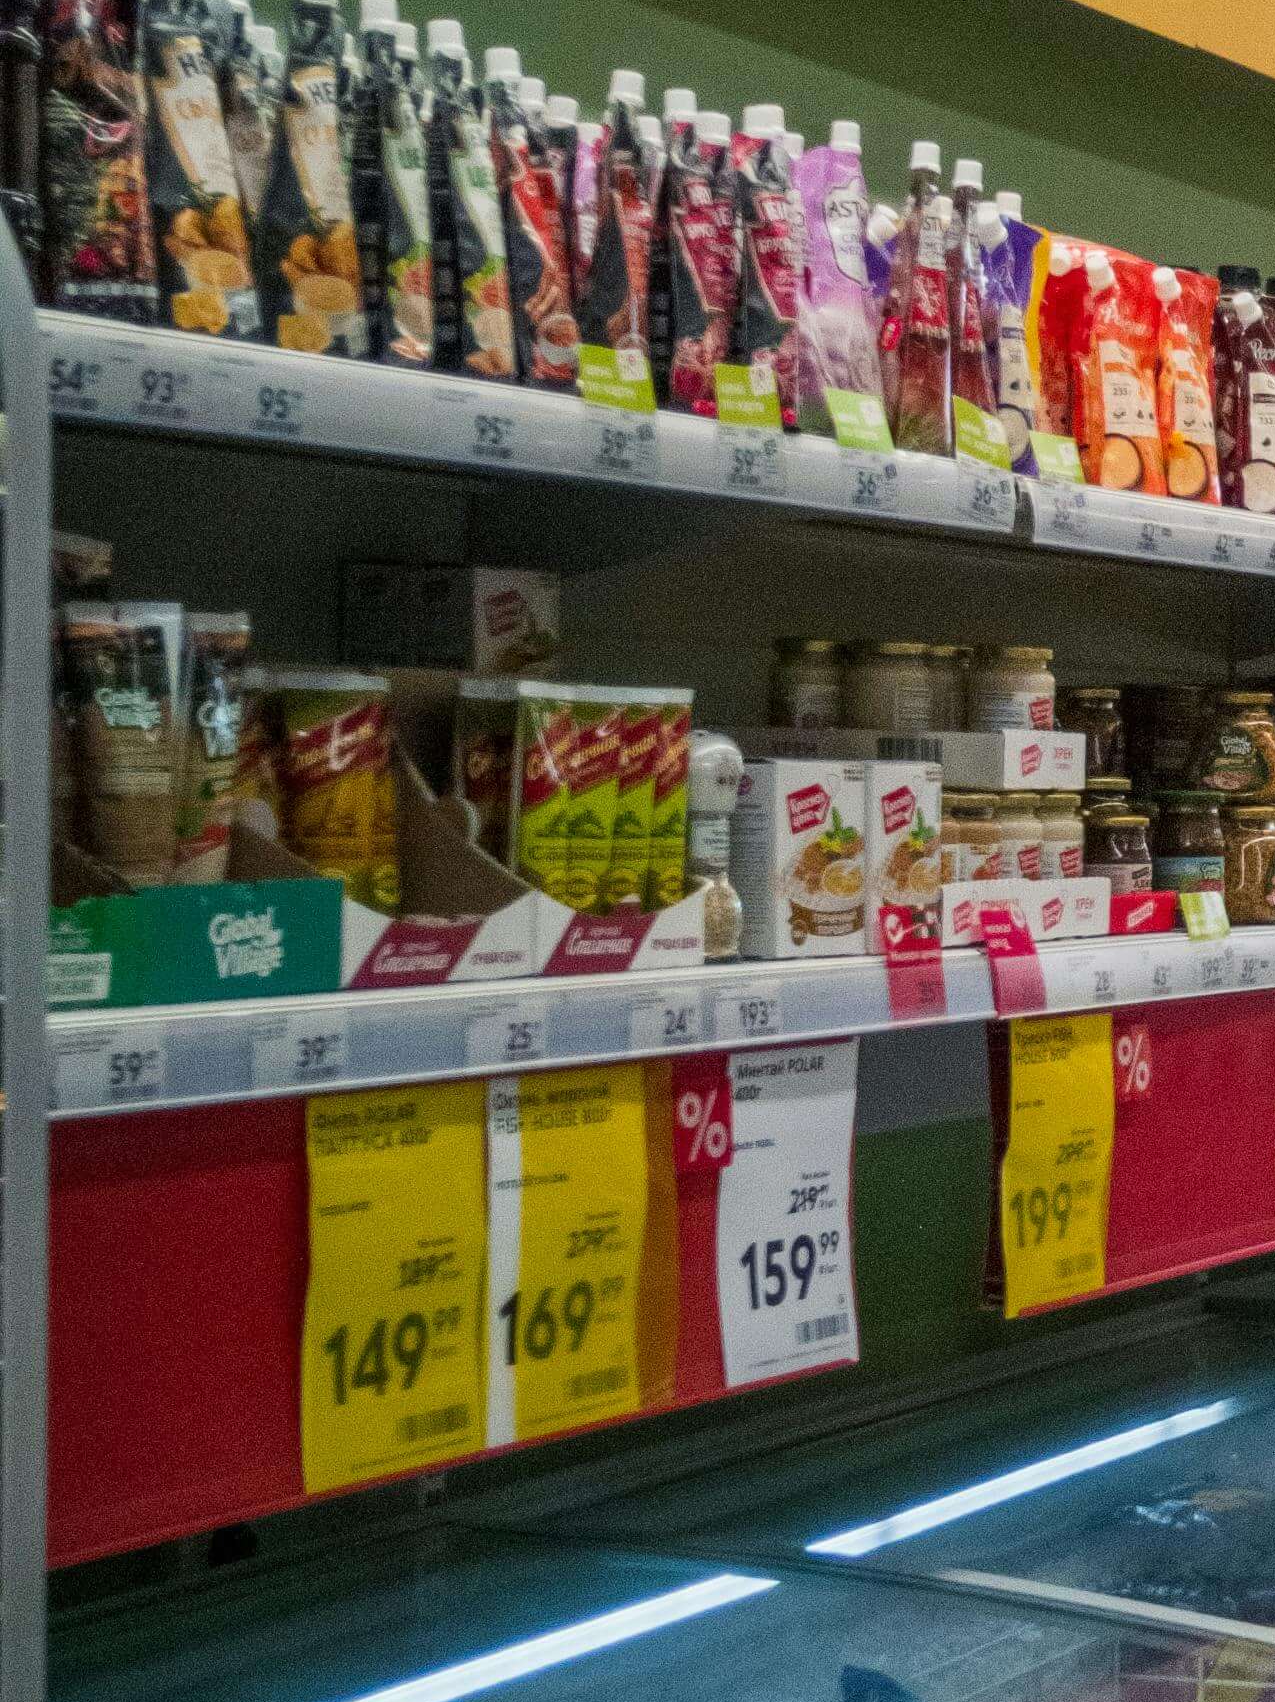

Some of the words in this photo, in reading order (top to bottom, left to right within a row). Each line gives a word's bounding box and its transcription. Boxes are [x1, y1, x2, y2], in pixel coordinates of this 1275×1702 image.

[676, 1089, 729, 1164] %
[739, 1232, 817, 1312] 159
[321, 1311, 431, 1406] 149
[498, 1278, 597, 1367] 169
